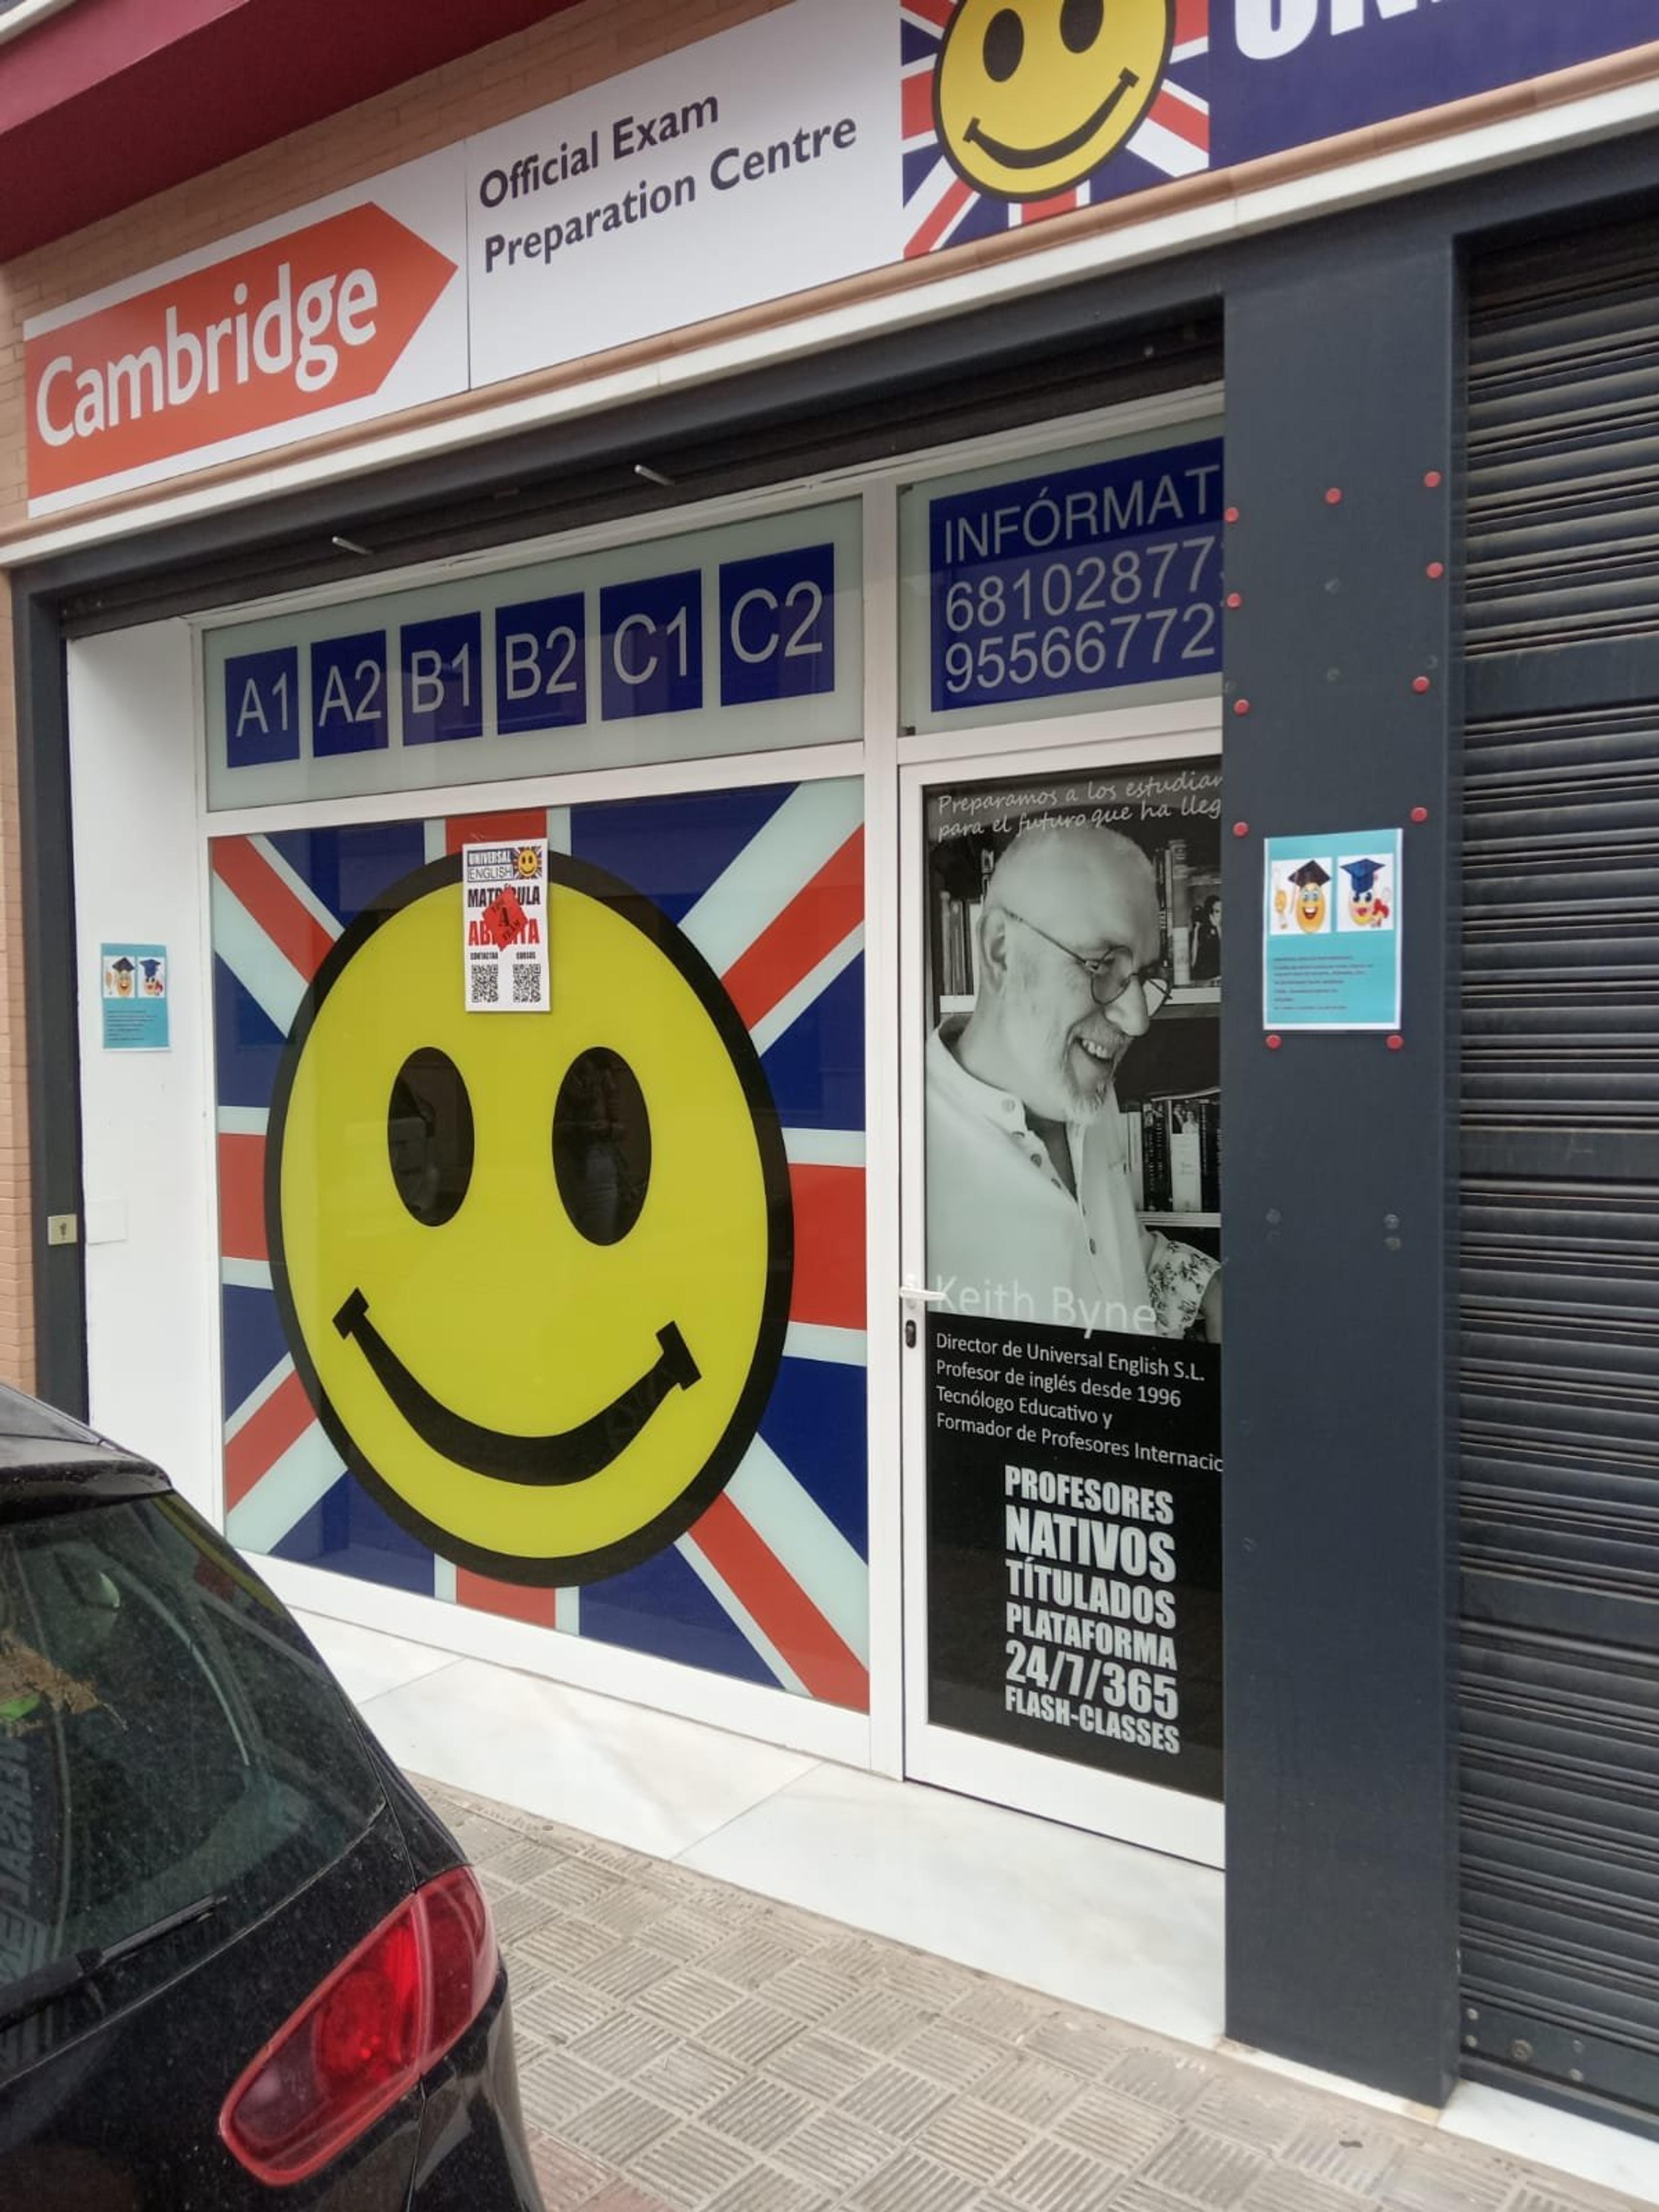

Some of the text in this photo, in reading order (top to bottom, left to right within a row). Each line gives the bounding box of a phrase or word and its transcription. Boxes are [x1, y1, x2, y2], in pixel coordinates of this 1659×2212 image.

[479, 95, 719, 208] Official Exam
[484, 115, 856, 273] Preparation Centre
[36, 262, 378, 447] Cambridge
[946, 535, 1224, 632] 68102877
[938, 822, 984, 842] para
[993, 815, 1012, 833] el
[1017, 812, 1086, 837] futuro
[1091, 806, 1133, 828] que
[1141, 800, 1172, 820] ha
[939, 791, 1057, 815] Preparamos
[1066, 789, 1078, 801] a
[1087, 781, 1117, 800] los
[468, 850, 511, 865] UNIVERSAL
[469, 867, 512, 880] ENGLISH
[468, 883, 541, 907] MATULA
[937, 1274, 1157, 1339] Keith Byne
[936, 1332, 1205, 1381] Director de Universal English S.L.
[937, 1359, 1182, 1407] Profesor de inglés desde 1996
[936, 1385, 1113, 1430] Tecnólogo Educativo y
[937, 1412, 1013, 1438] Formador
[1016, 1424, 1037, 1443] de
[1042, 1428, 1130, 1457] Profesores
[1004, 1465, 1174, 1525] PROFESORES
[1005, 1504, 1176, 1583] NATIVOS
[1005, 1556, 1176, 1630] TÍTULADOS
[1006, 1601, 1177, 1671] PLATAFORMA
[1005, 1640, 1179, 1720] 24/7/365
[1005, 1684, 1180, 1754] FLASH-CLASSES
